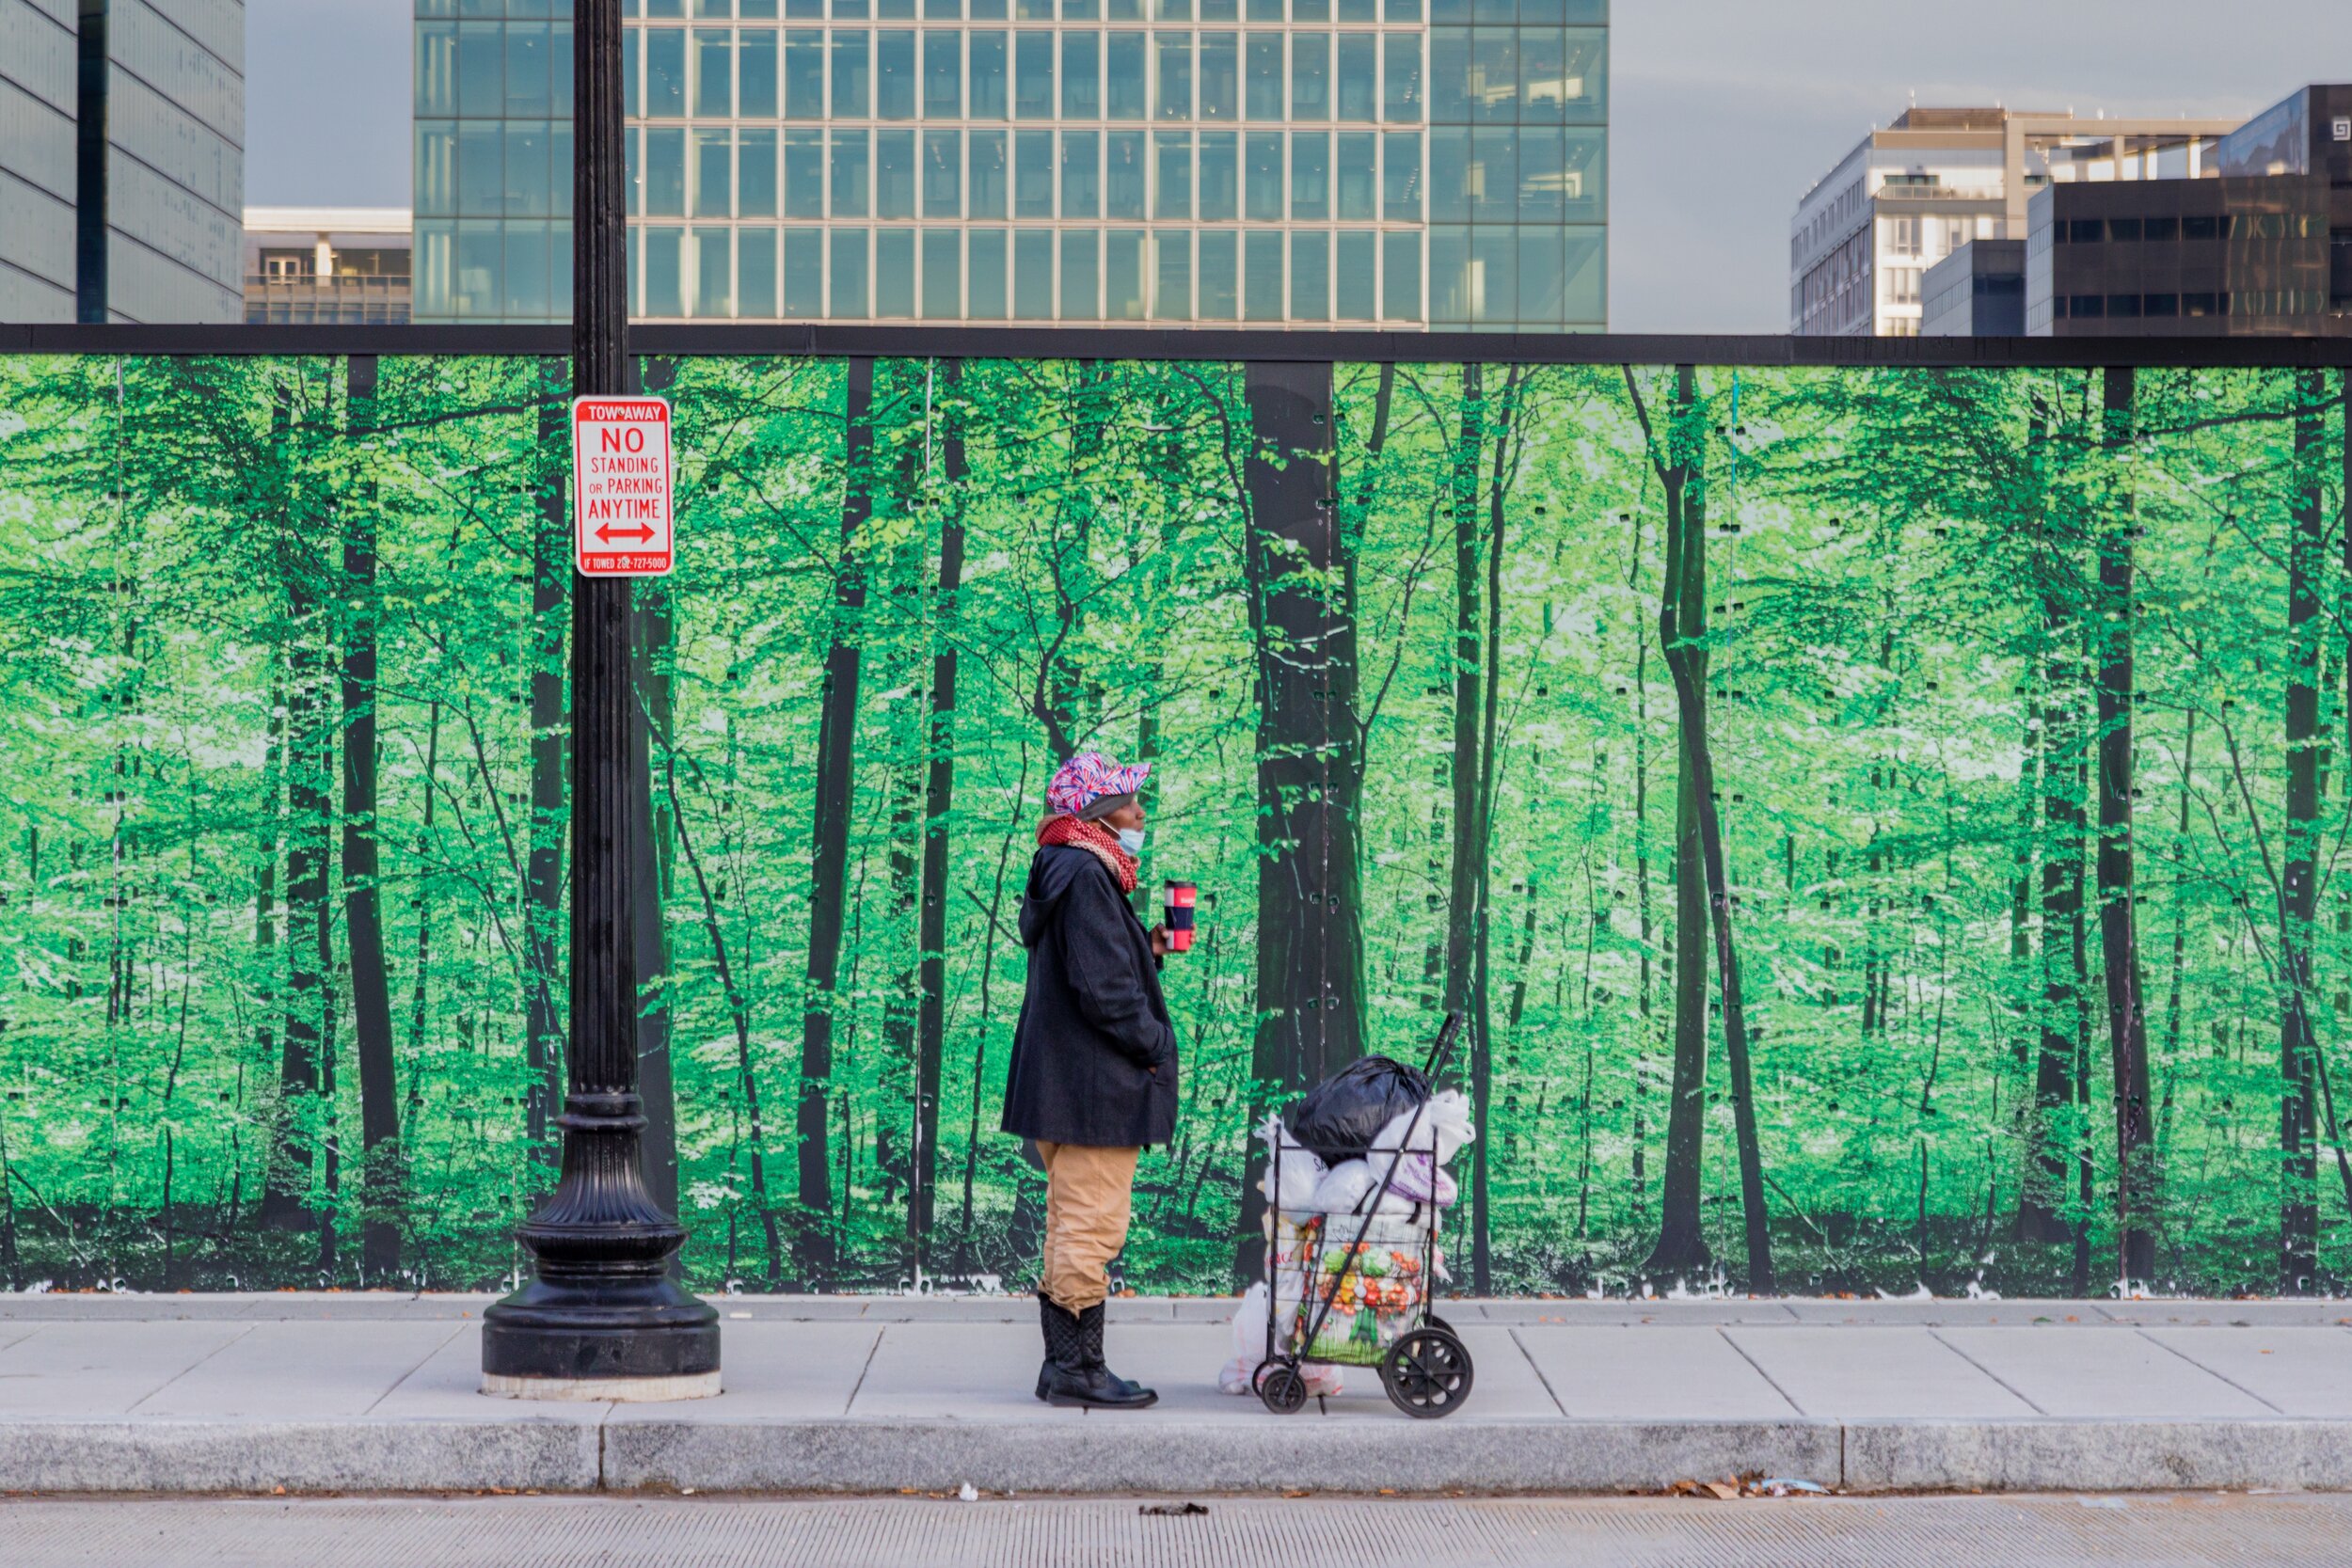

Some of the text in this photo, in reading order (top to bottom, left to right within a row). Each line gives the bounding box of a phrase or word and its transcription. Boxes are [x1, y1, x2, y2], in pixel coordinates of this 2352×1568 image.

[601, 427, 644, 453] NO
[591, 457, 659, 473] STANDING
[589, 478, 662, 494] OR PARKING
[588, 499, 660, 519] ANYTIME
[584, 558, 591, 569] IF
[593, 558, 614, 569] TOWED
